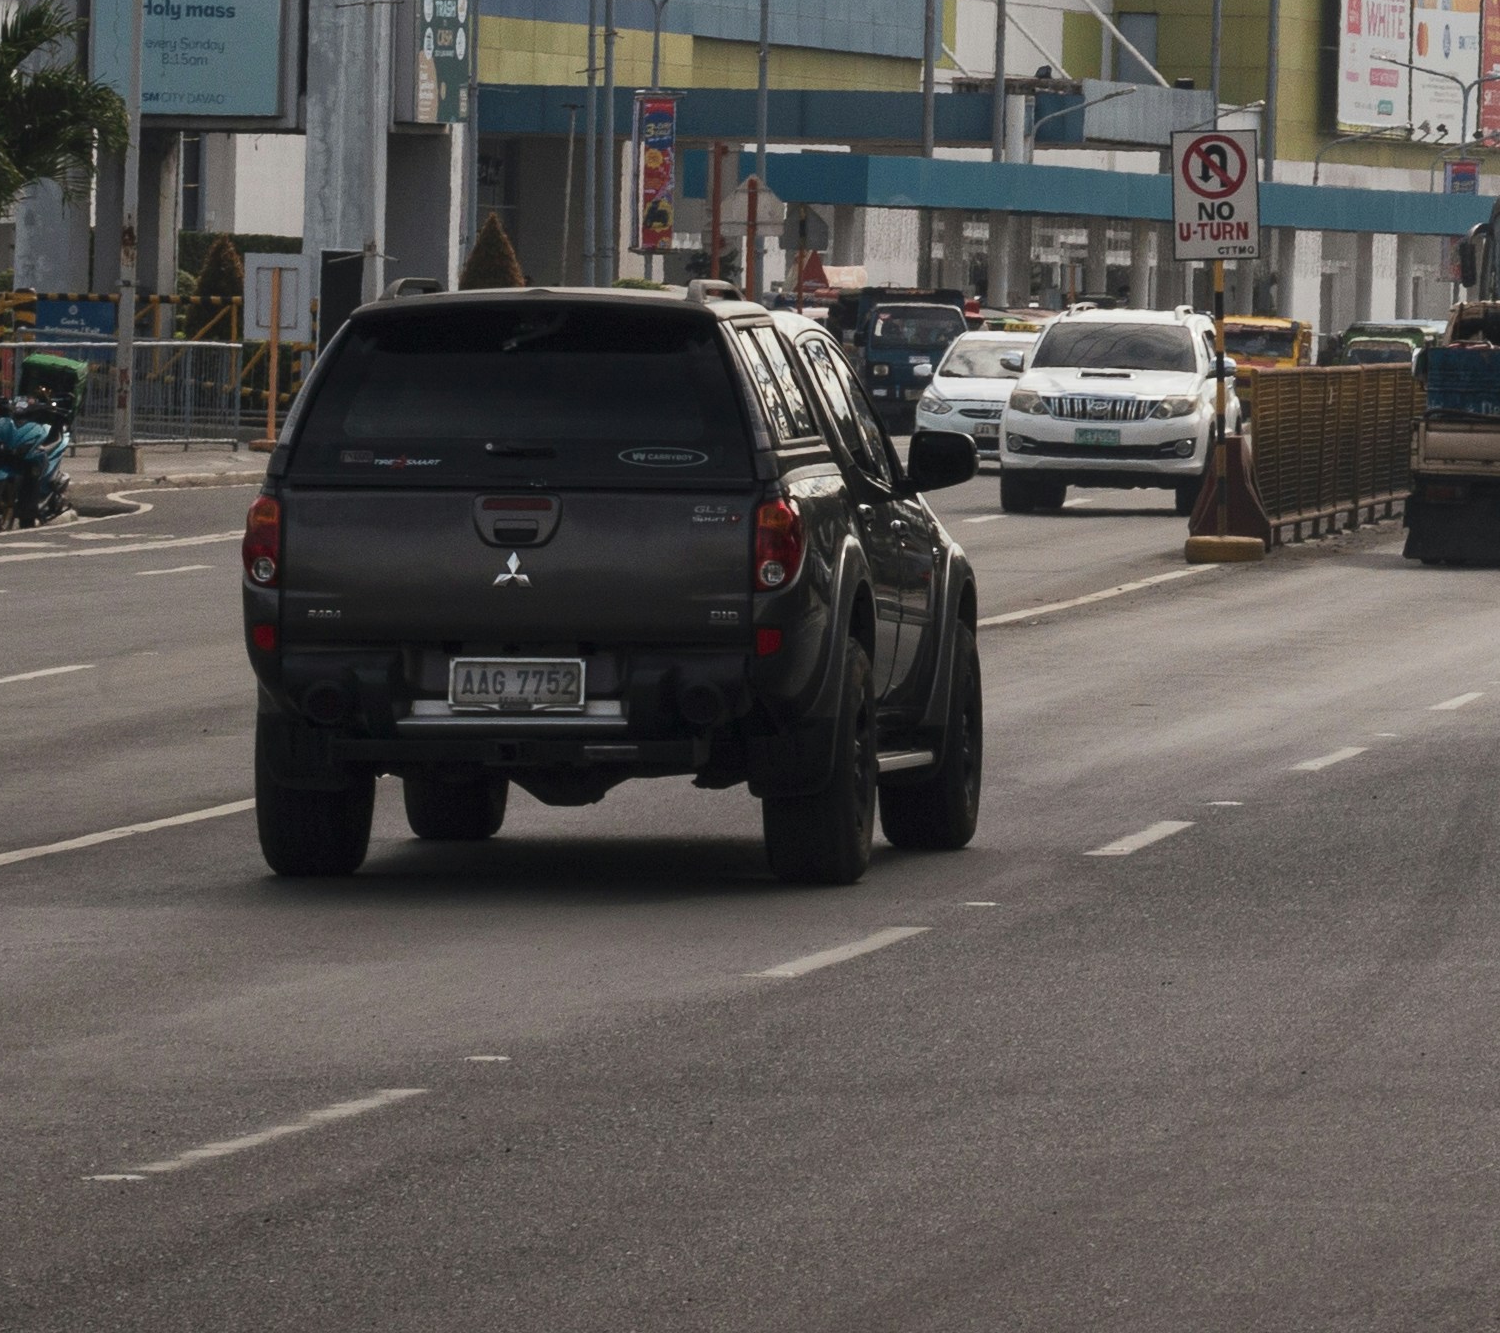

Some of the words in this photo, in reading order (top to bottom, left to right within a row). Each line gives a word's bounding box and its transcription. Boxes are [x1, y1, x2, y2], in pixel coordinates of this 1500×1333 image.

[186, 5, 236, 18] mass
[1366, 0, 1406, 40] WHITE
[180, 37, 226, 54] Sunday
[1198, 201, 1235, 221] NO
[1178, 222, 1249, 242] U-TURN
[460, 671, 506, 696] AAG
[516, 670, 577, 696] 7752
